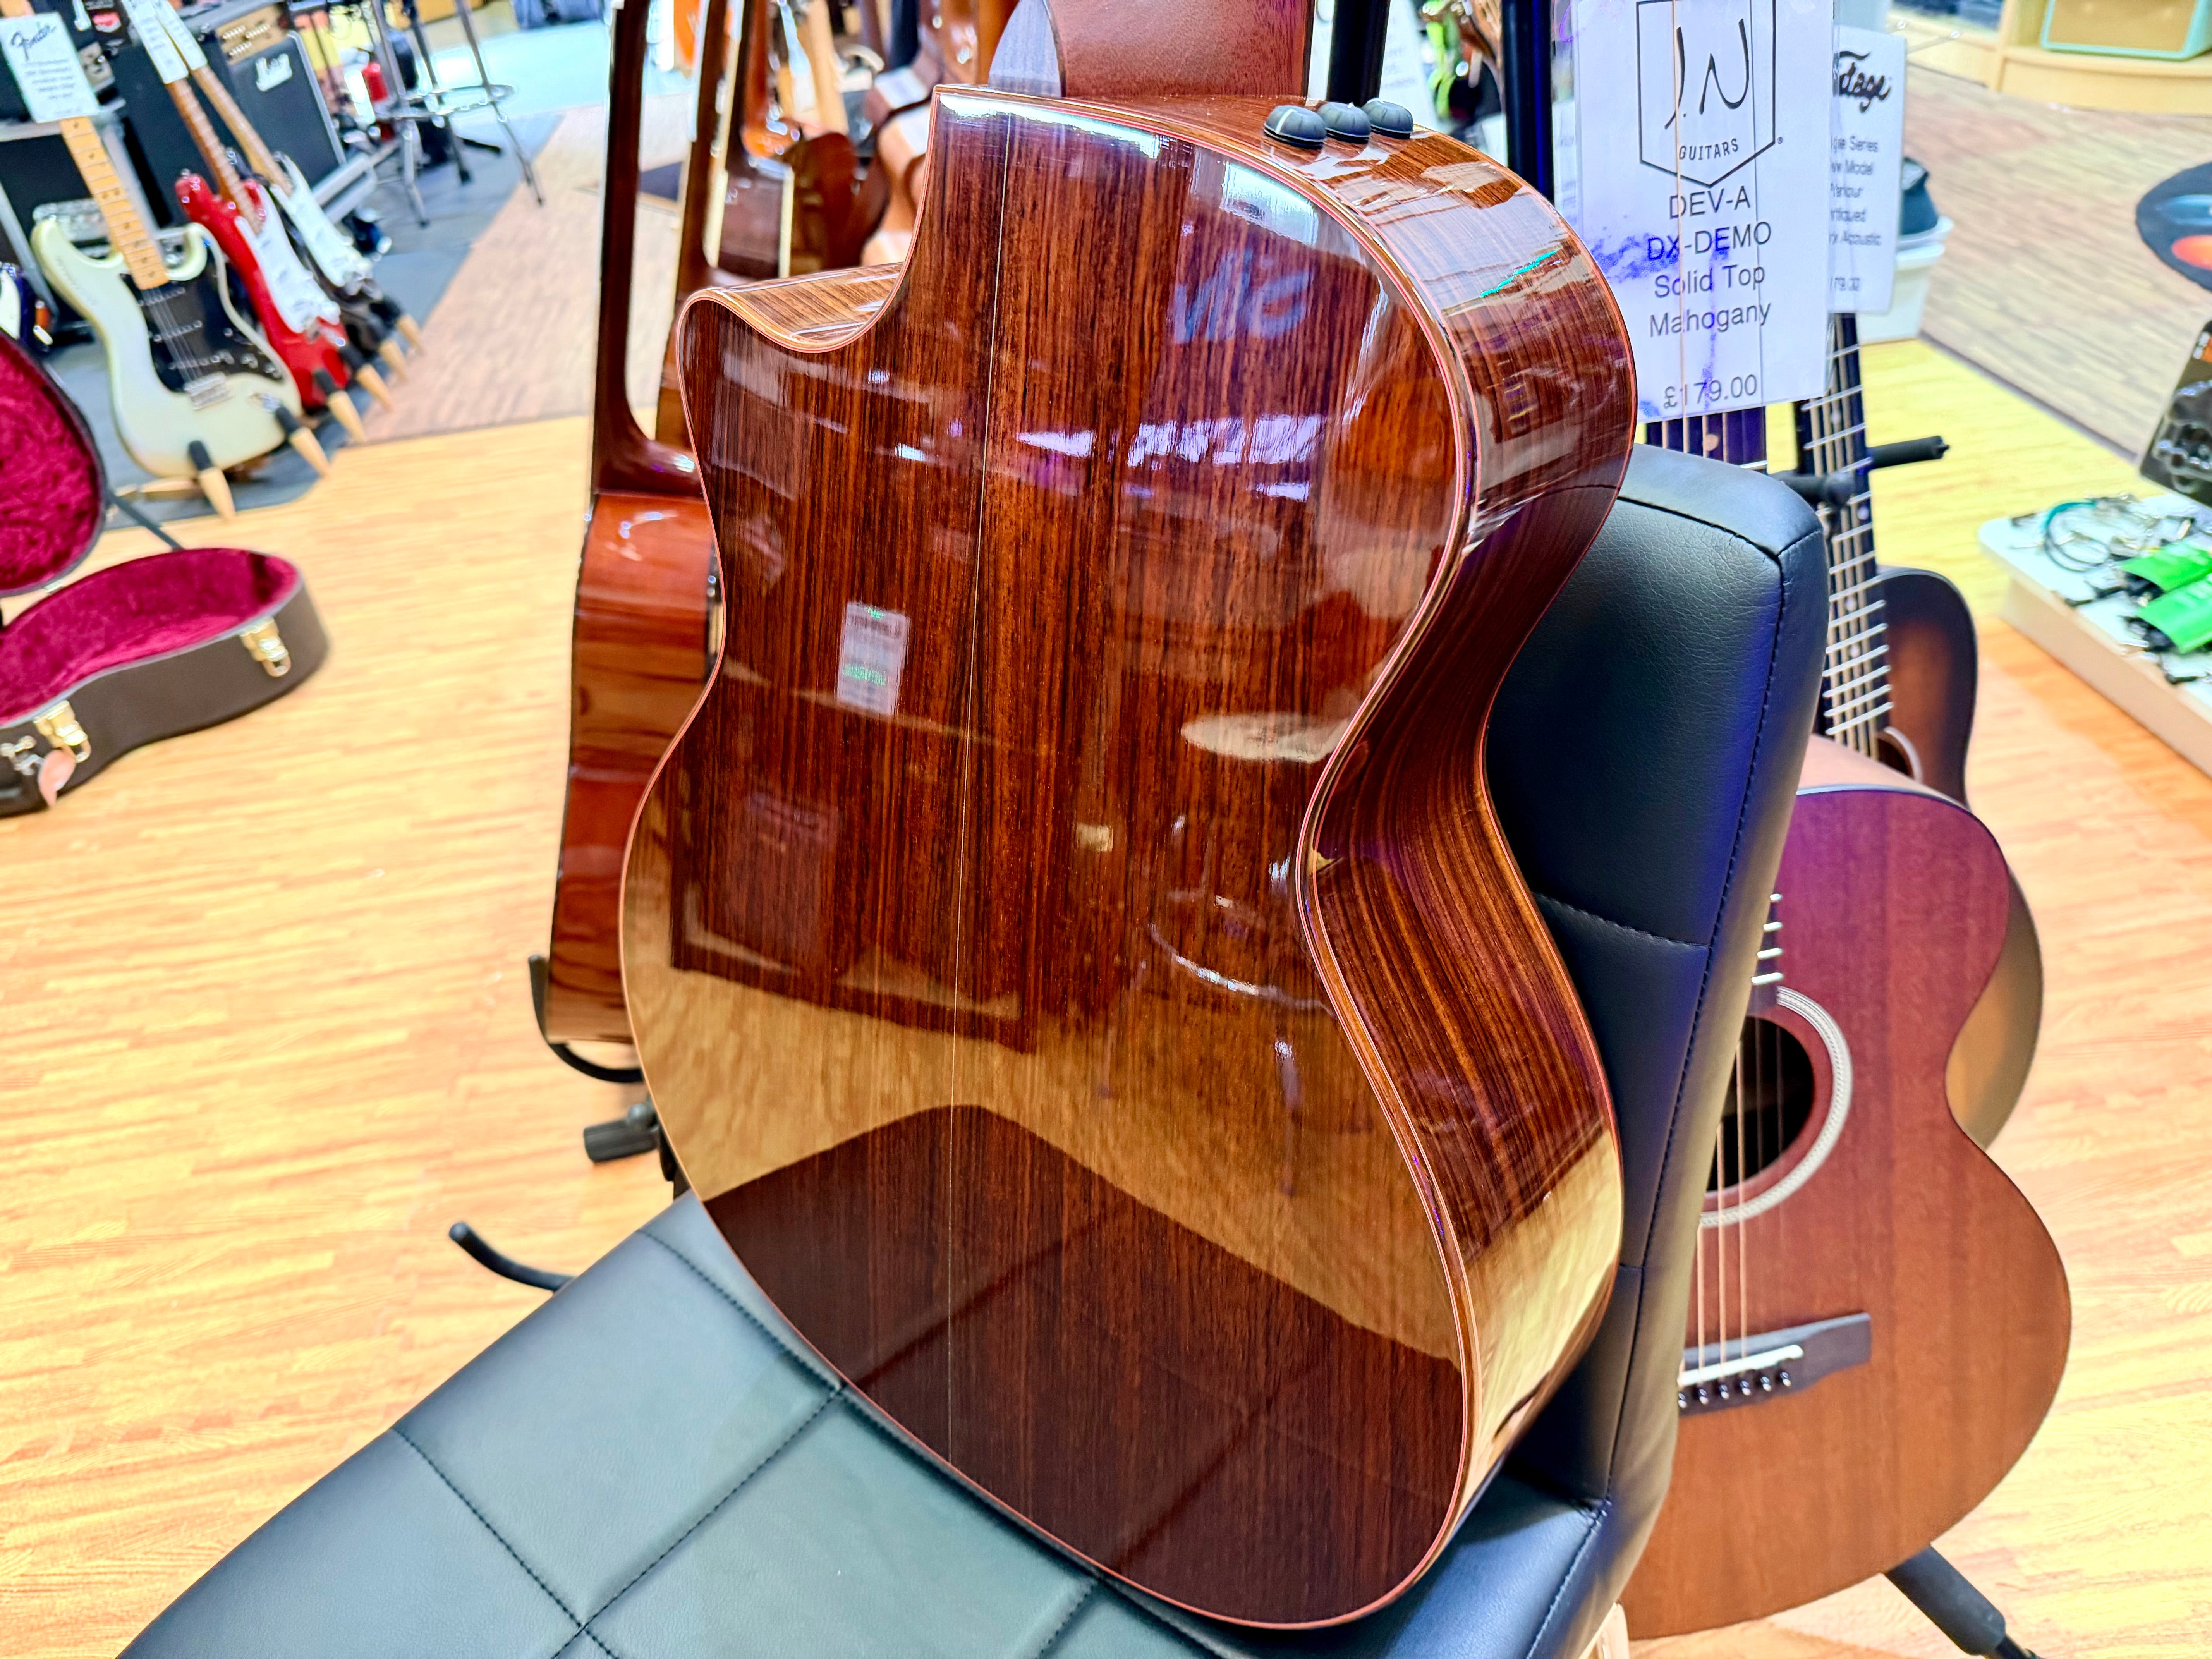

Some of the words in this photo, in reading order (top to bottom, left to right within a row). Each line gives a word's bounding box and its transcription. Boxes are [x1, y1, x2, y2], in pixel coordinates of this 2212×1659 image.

[1679, 138, 1739, 161] GUITARS
[1669, 185, 1750, 219] DEV-A
[1648, 221, 1771, 261] DX-DEMO
[1654, 267, 1712, 298] Solid
[1722, 264, 1765, 290] Top
[1650, 302, 1771, 337] Mahogany
[1663, 374, 1757, 409] £179.00
